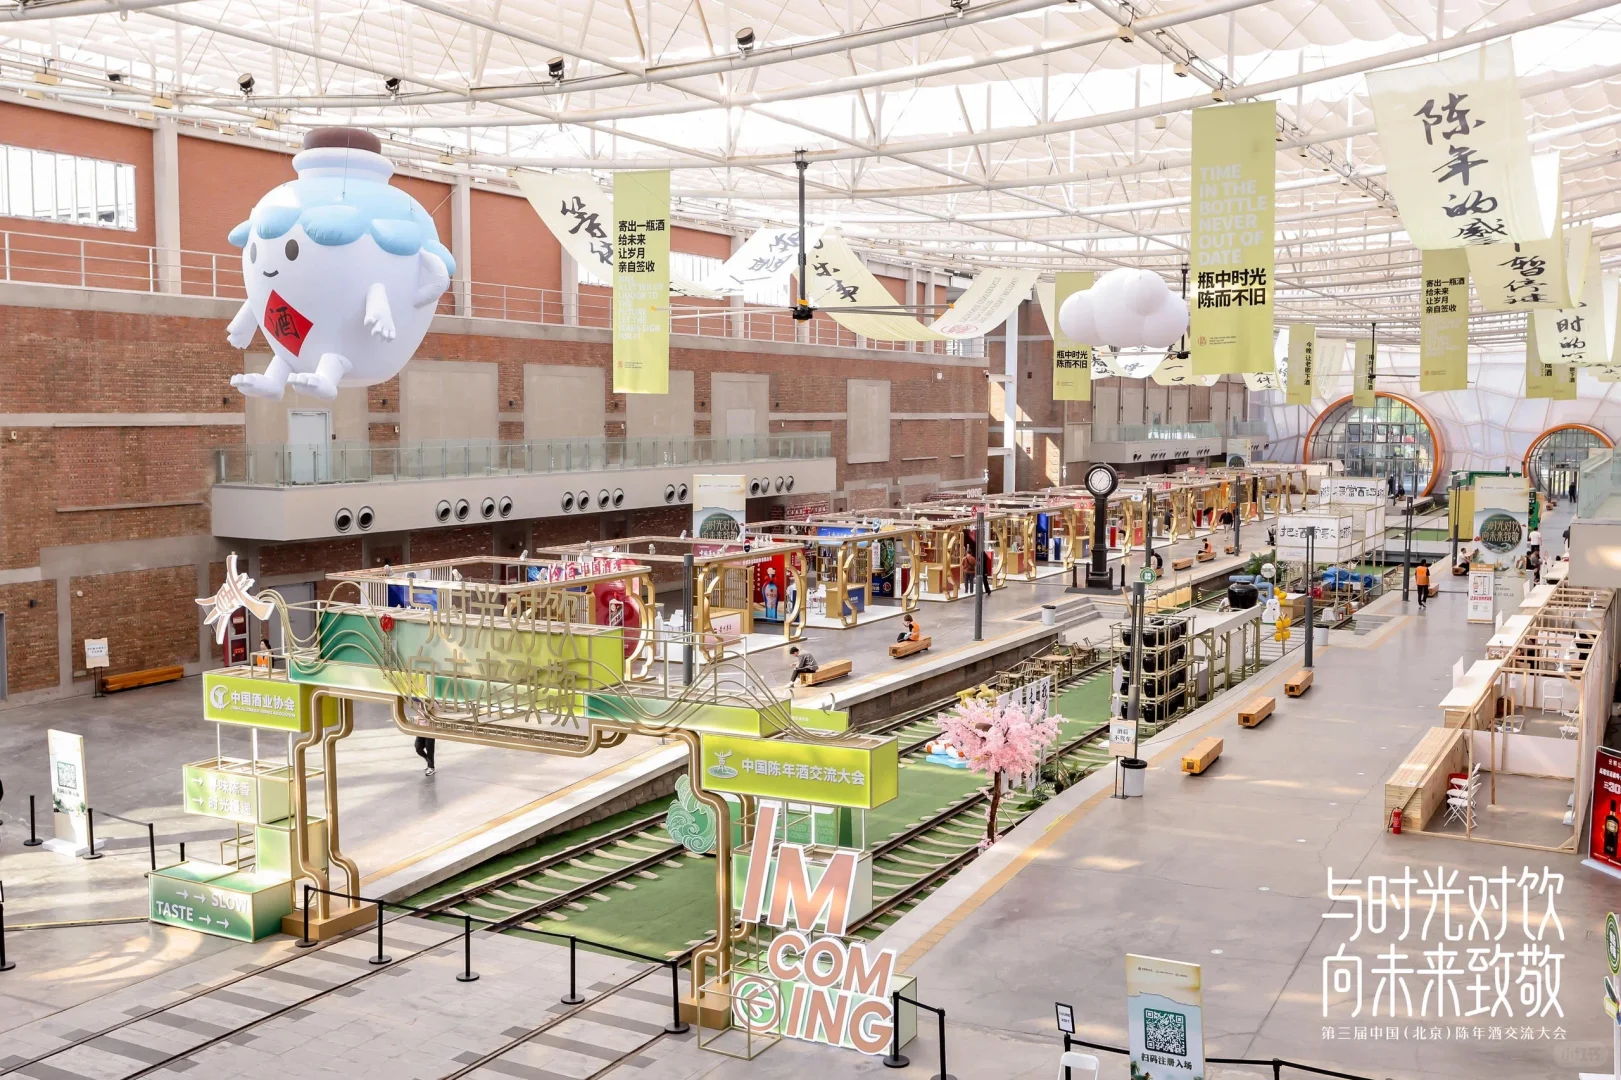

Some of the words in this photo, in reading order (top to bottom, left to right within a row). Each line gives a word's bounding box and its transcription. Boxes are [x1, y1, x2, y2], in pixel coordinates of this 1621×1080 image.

[1200, 164, 1242, 181] TIME
[1200, 183, 1217, 198] IN
[1221, 180, 1257, 196] THE
[1199, 196, 1268, 215] BOTTLE
[618, 219, 665, 232] 寄出一瓶酒
[1199, 214, 1258, 233] NEVER
[618, 233, 646, 246] 给未来
[1199, 232, 1237, 249] OUT
[1240, 231, 1265, 247] OF
[618, 247, 645, 259] 让岁月
[1199, 248, 1242, 266] DATE
[618, 260, 656, 273] 亲自签收
[1198, 267, 1266, 289] 瓶中时光
[1426, 277, 1465, 288] 寄出一瓶酒
[618, 291, 646, 299] LIQUOR
[648, 291, 659, 299] TO
[1198, 287, 1266, 309] 陈而不旧
[1425, 288, 1449, 296] 给未来
[1425, 296, 1449, 305] 让岁月
[1425, 304, 1457, 313] 亲自签收
[269, 305, 301, 339] 酒
[1056, 350, 1088, 359] 瓶中时光
[1056, 359, 1088, 369] 陈而不旧
[409, 577, 579, 659] 与时光对饮
[408, 645, 580, 730] 向未来致敬
[231, 690, 295, 712] 中国酒业协会
[741, 758, 865, 786] 中国陈年酒交流大会
[155, 900, 194, 922] TASTE
[212, 891, 248, 914] SLOW
[766, 929, 897, 998] COM
[785, 983, 895, 1056] ING
[1140, 1052, 1193, 1070] 扫码注册入场
